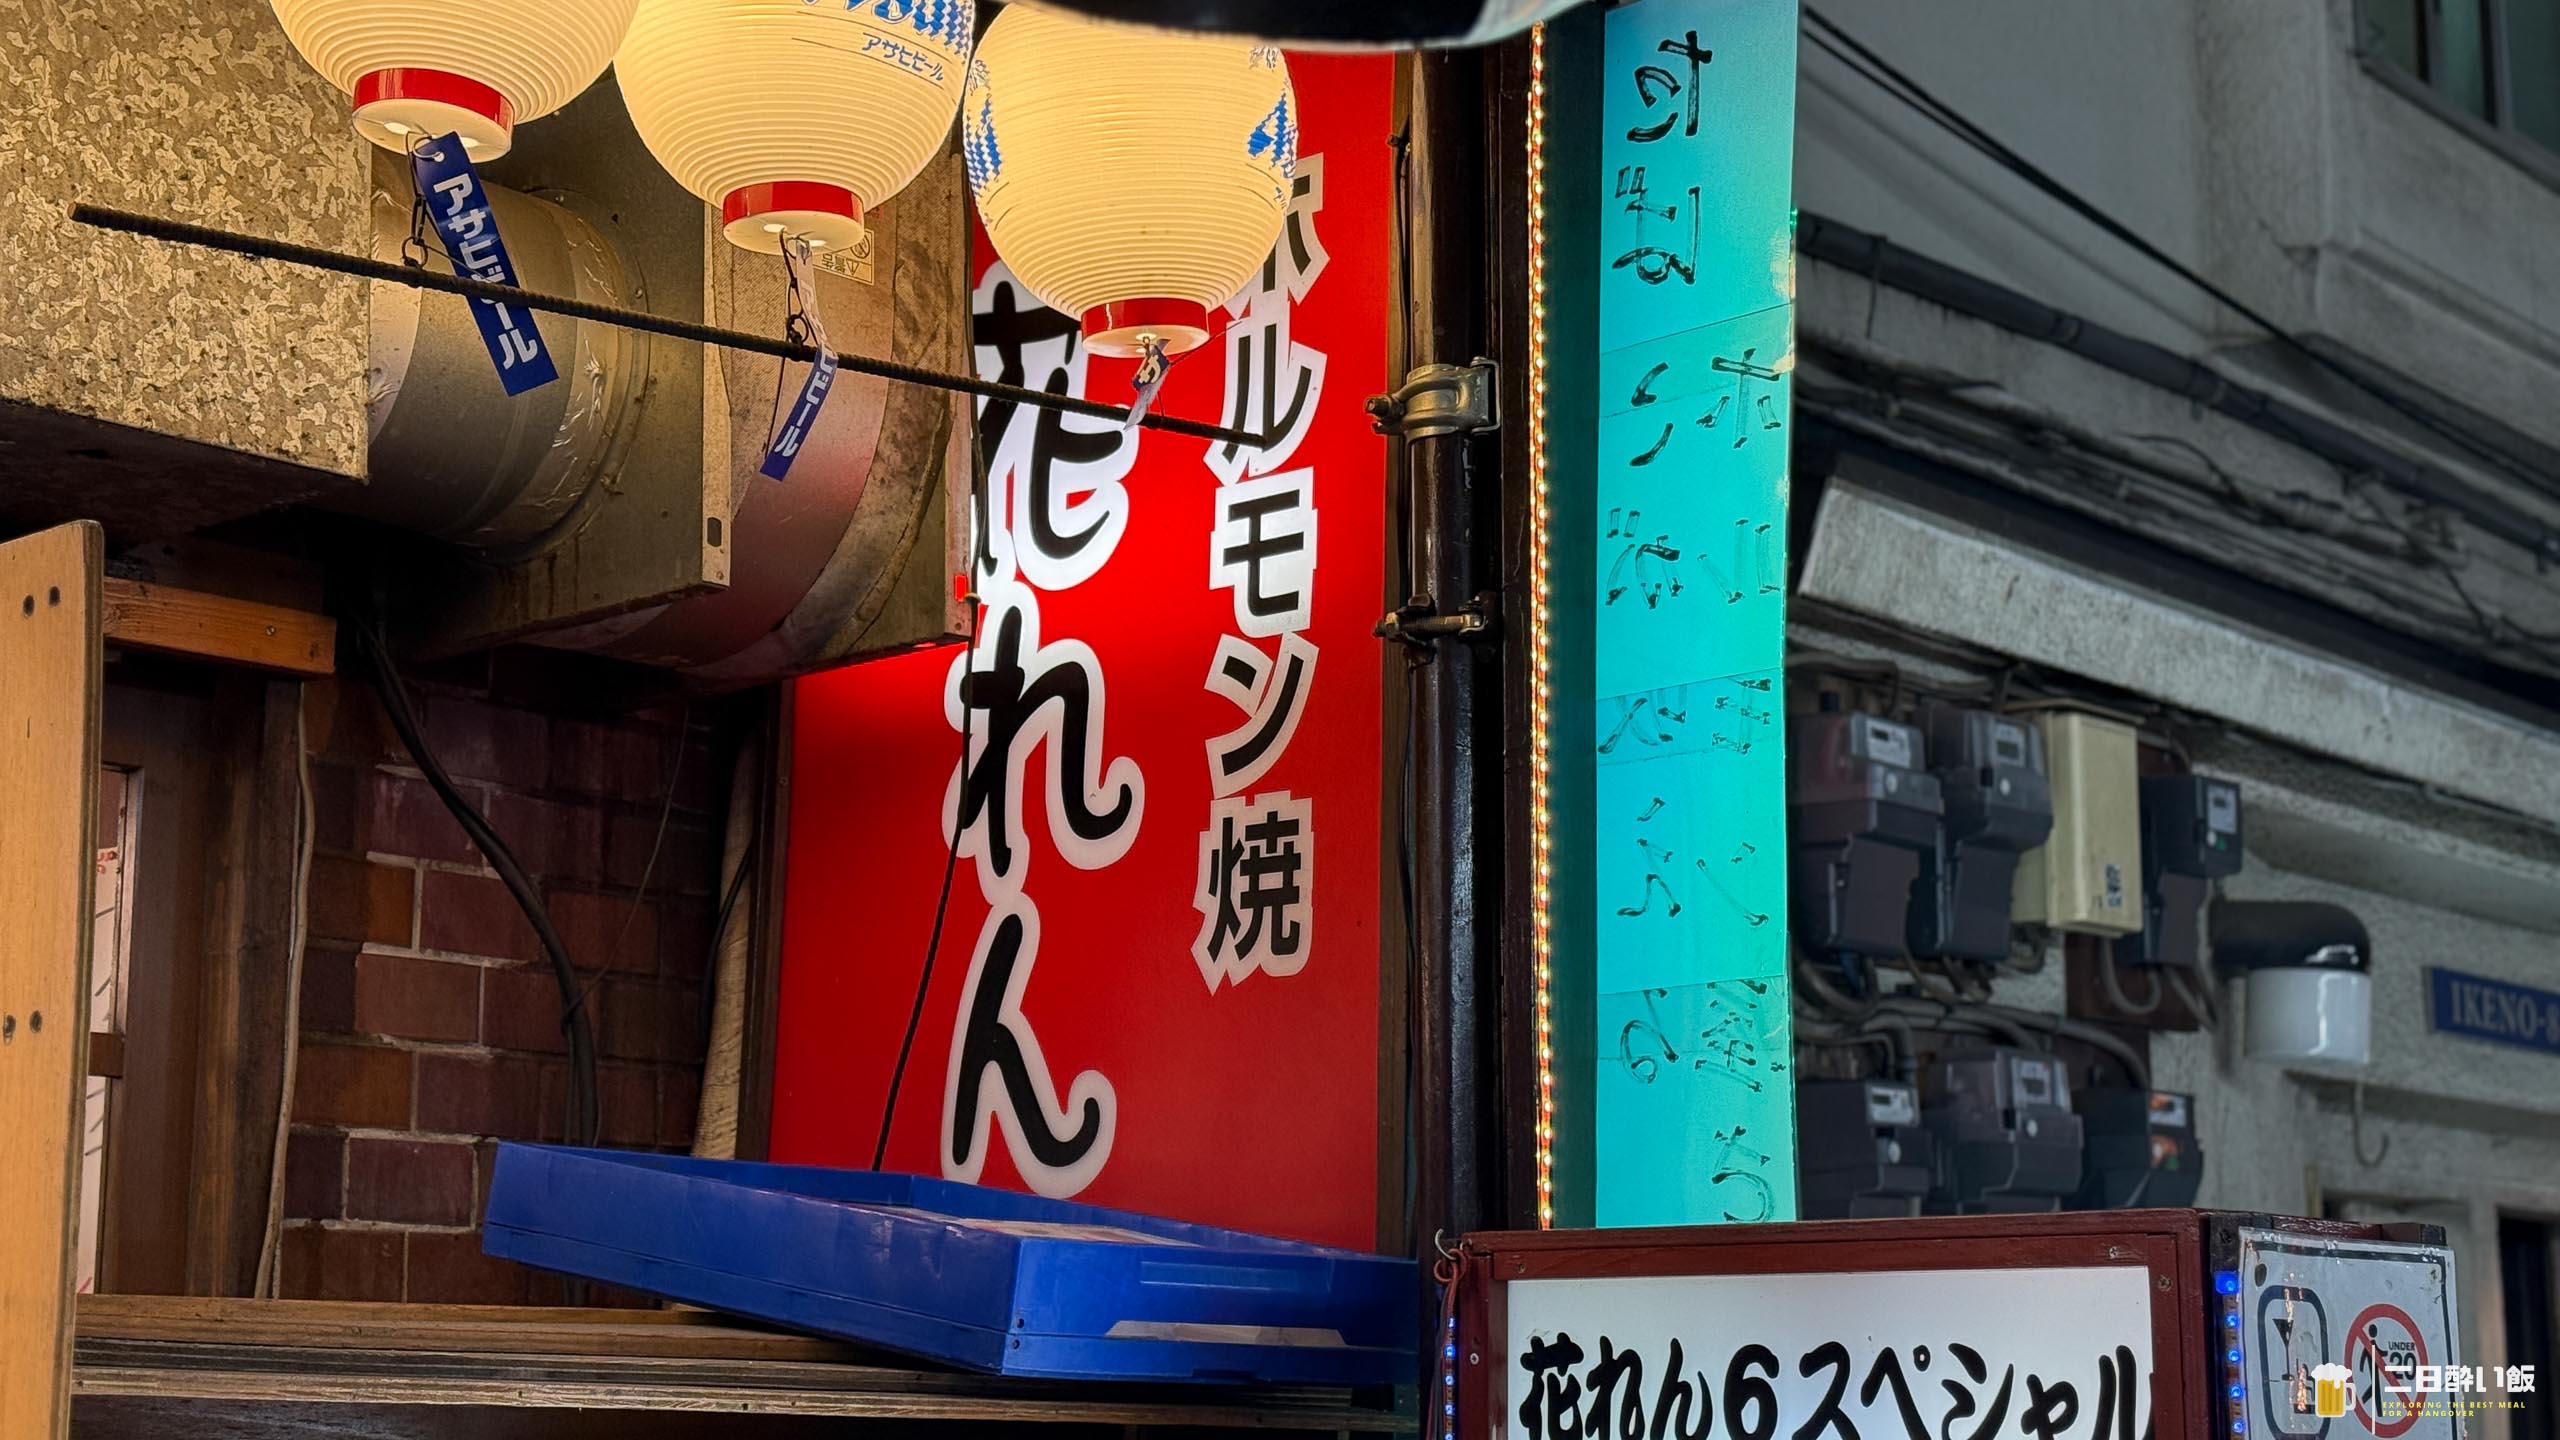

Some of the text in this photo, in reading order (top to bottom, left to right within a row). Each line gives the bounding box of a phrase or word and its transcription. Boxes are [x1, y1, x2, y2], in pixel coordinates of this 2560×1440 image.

[861, 31, 944, 81] アサヒビール
[2388, 1341, 2416, 1351] UNDER
[2389, 1351, 2417, 1380] 20
